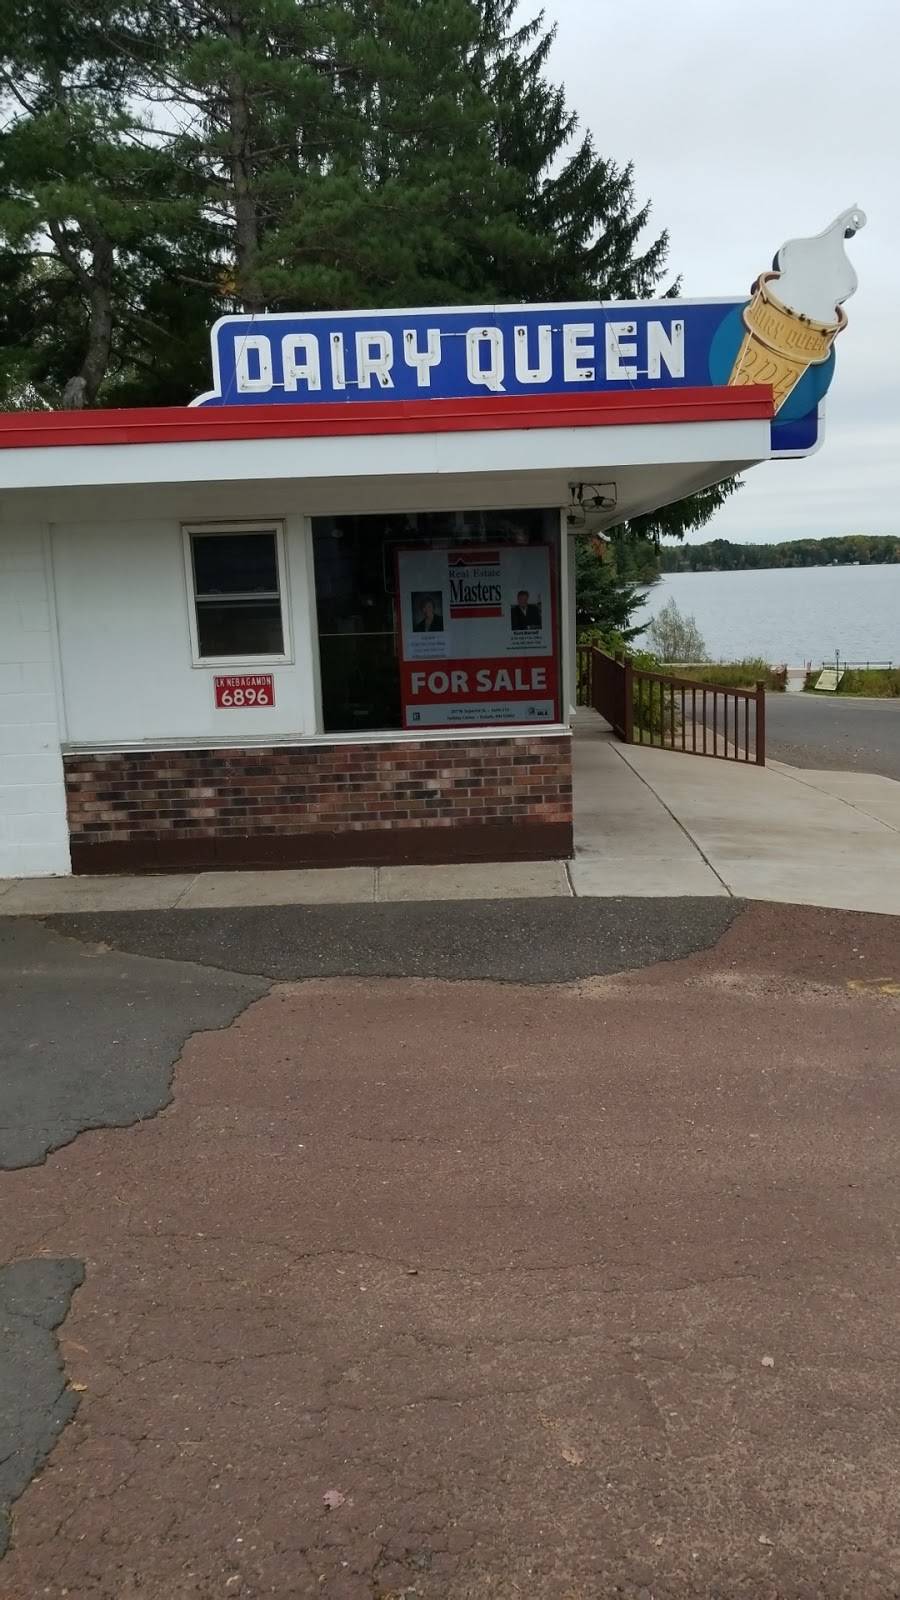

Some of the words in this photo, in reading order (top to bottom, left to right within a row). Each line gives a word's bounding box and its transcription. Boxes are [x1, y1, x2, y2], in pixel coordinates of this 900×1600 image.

[234, 329, 442, 393] DAIRY
[465, 320, 685, 391] QUEEN
[449, 569, 469, 579] Real
[473, 567, 502, 578] Estate
[449, 579, 502, 603] Masters
[216, 678, 225, 688] LK
[227, 676, 271, 687] NEBAGAMON
[411, 670, 469, 695] FOR
[476, 667, 547, 692] SALE
[221, 688, 268, 706] 6896
